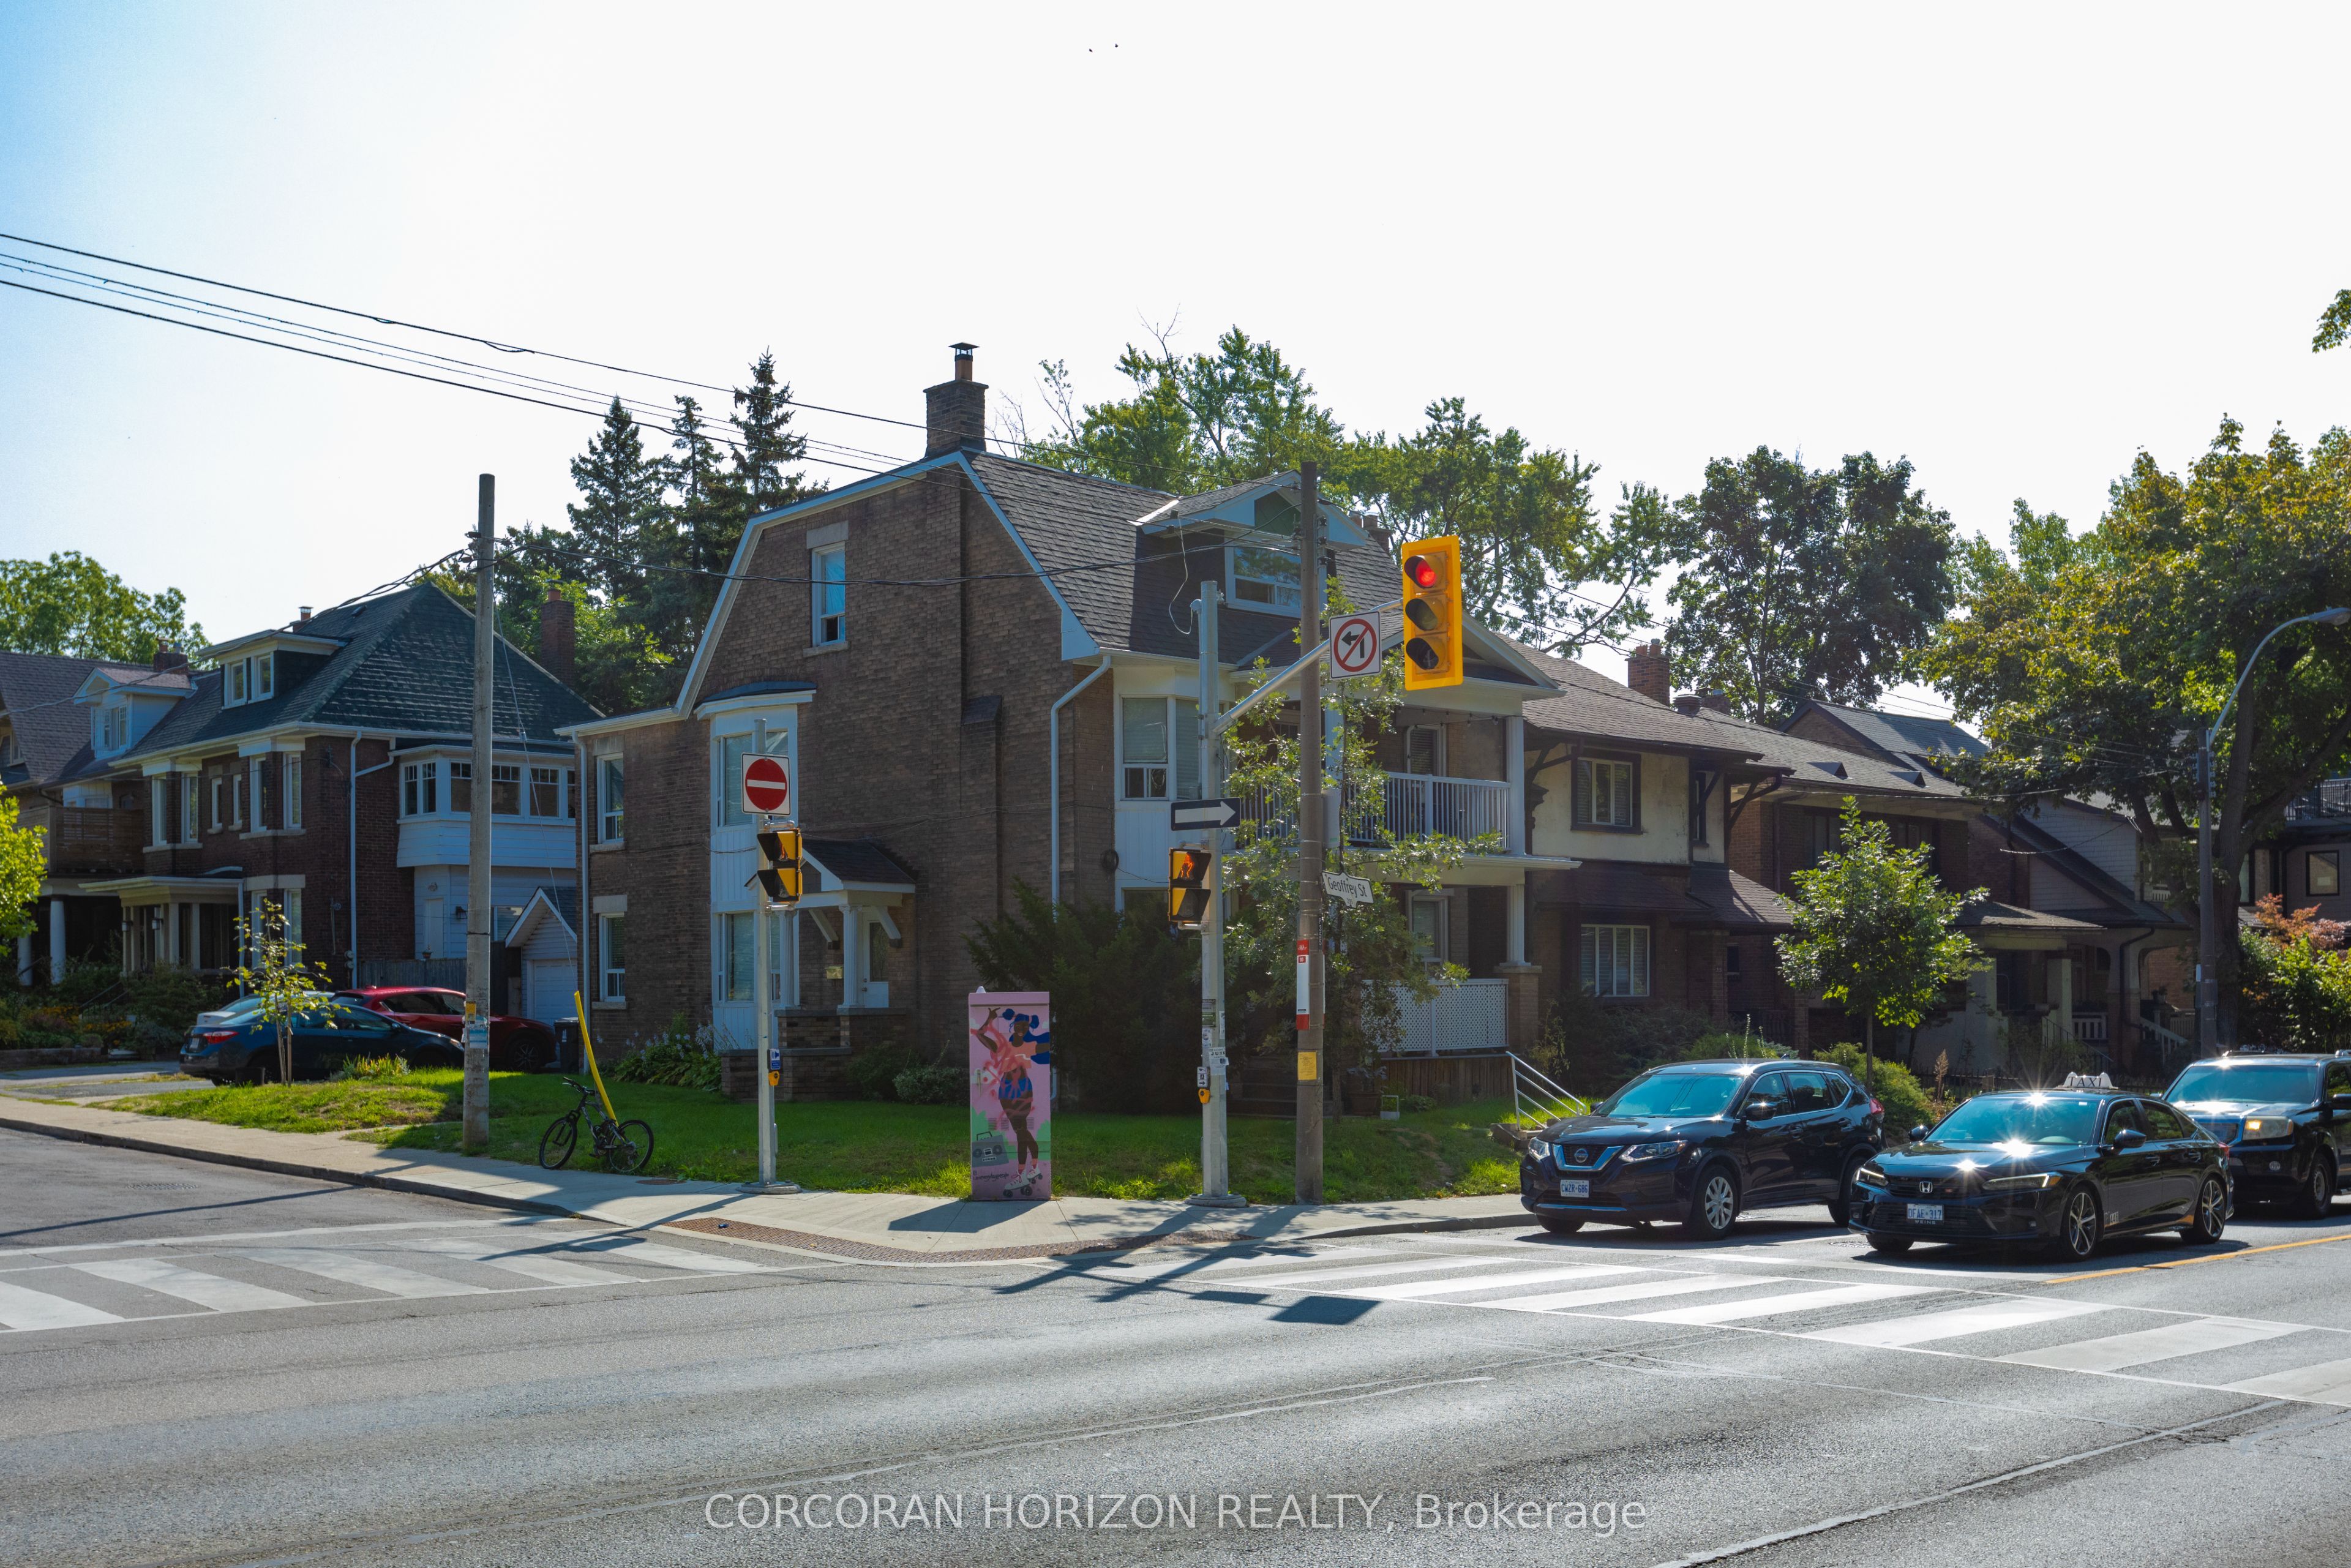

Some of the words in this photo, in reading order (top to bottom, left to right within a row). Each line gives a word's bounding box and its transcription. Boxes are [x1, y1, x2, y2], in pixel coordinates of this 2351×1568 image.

[1328, 877, 1357, 898] Geoffrey
[1358, 883, 1368, 897] St
[2068, 1076, 2102, 1087] TAXI
[1929, 1209, 1941, 1219] 317
